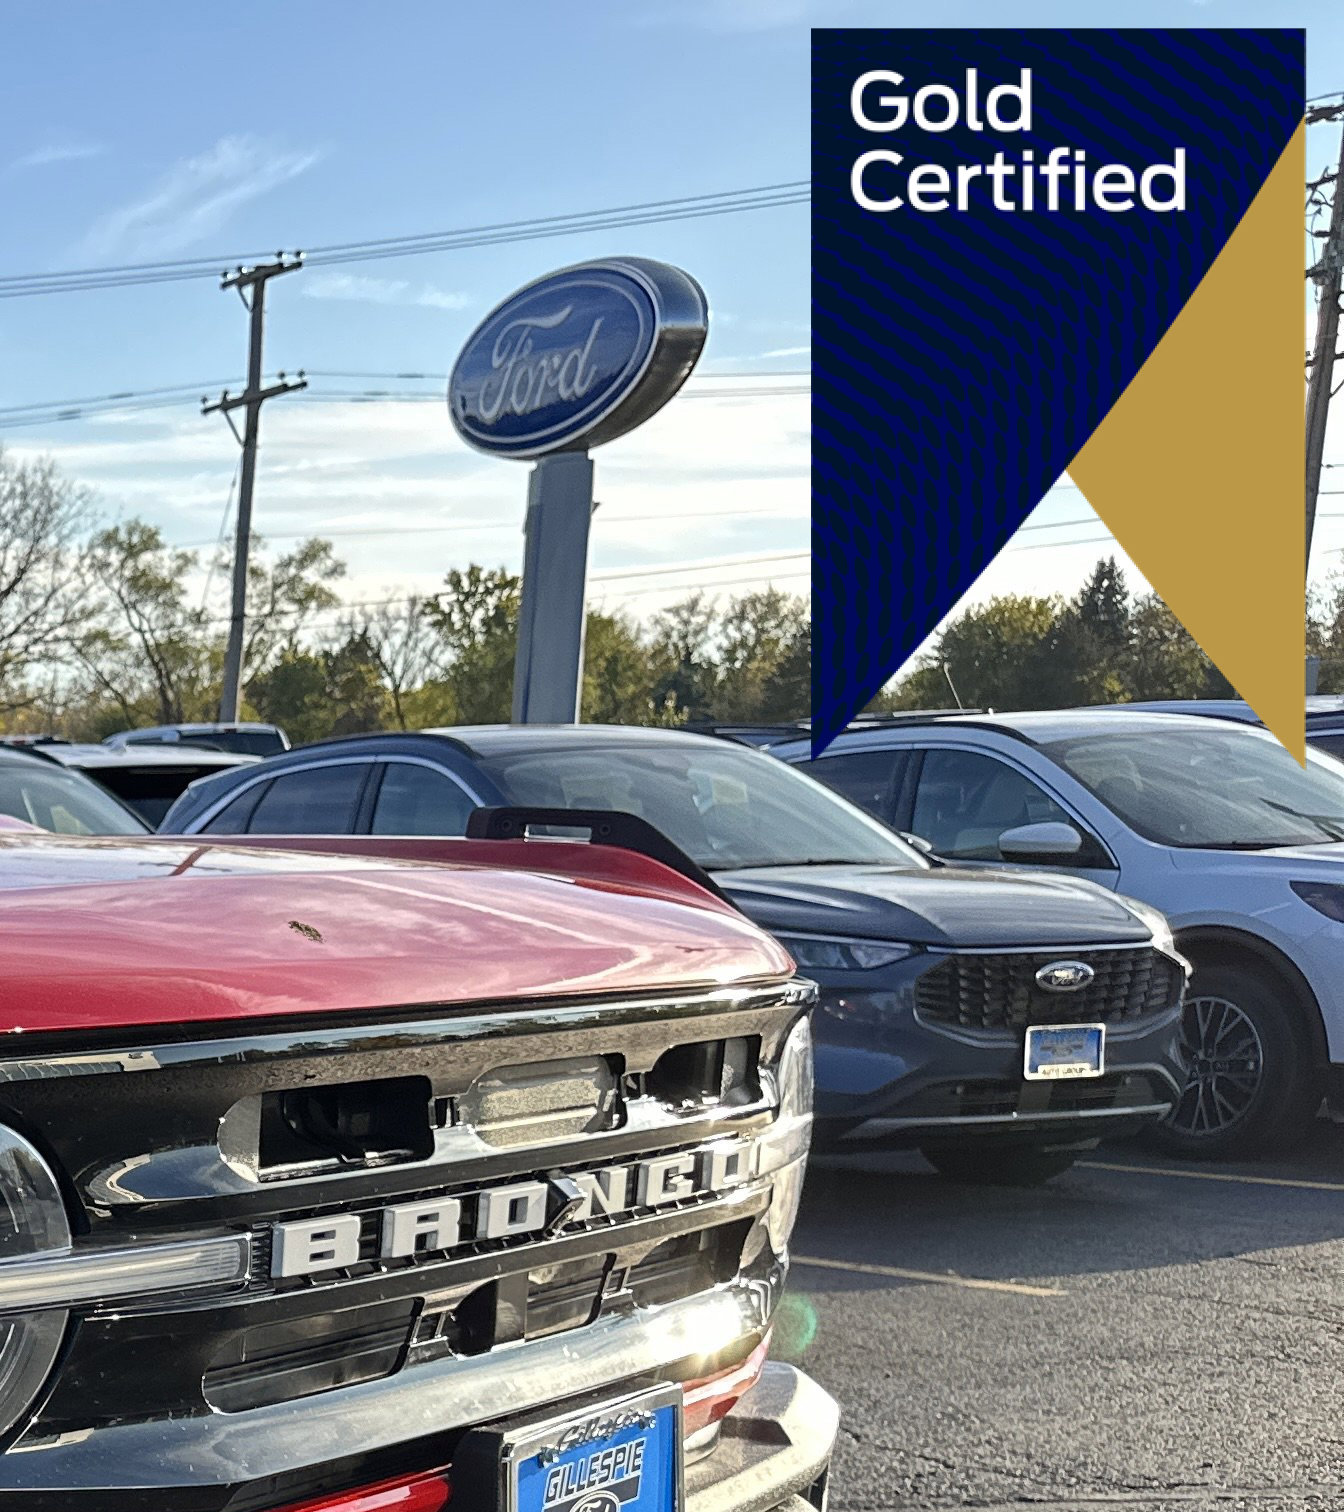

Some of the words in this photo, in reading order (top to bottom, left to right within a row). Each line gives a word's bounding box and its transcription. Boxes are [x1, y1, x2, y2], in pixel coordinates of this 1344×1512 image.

[478, 304, 605, 426] Ford
[271, 1136, 756, 1280] BRONCO
[544, 1437, 647, 1505] GILLESPIE
